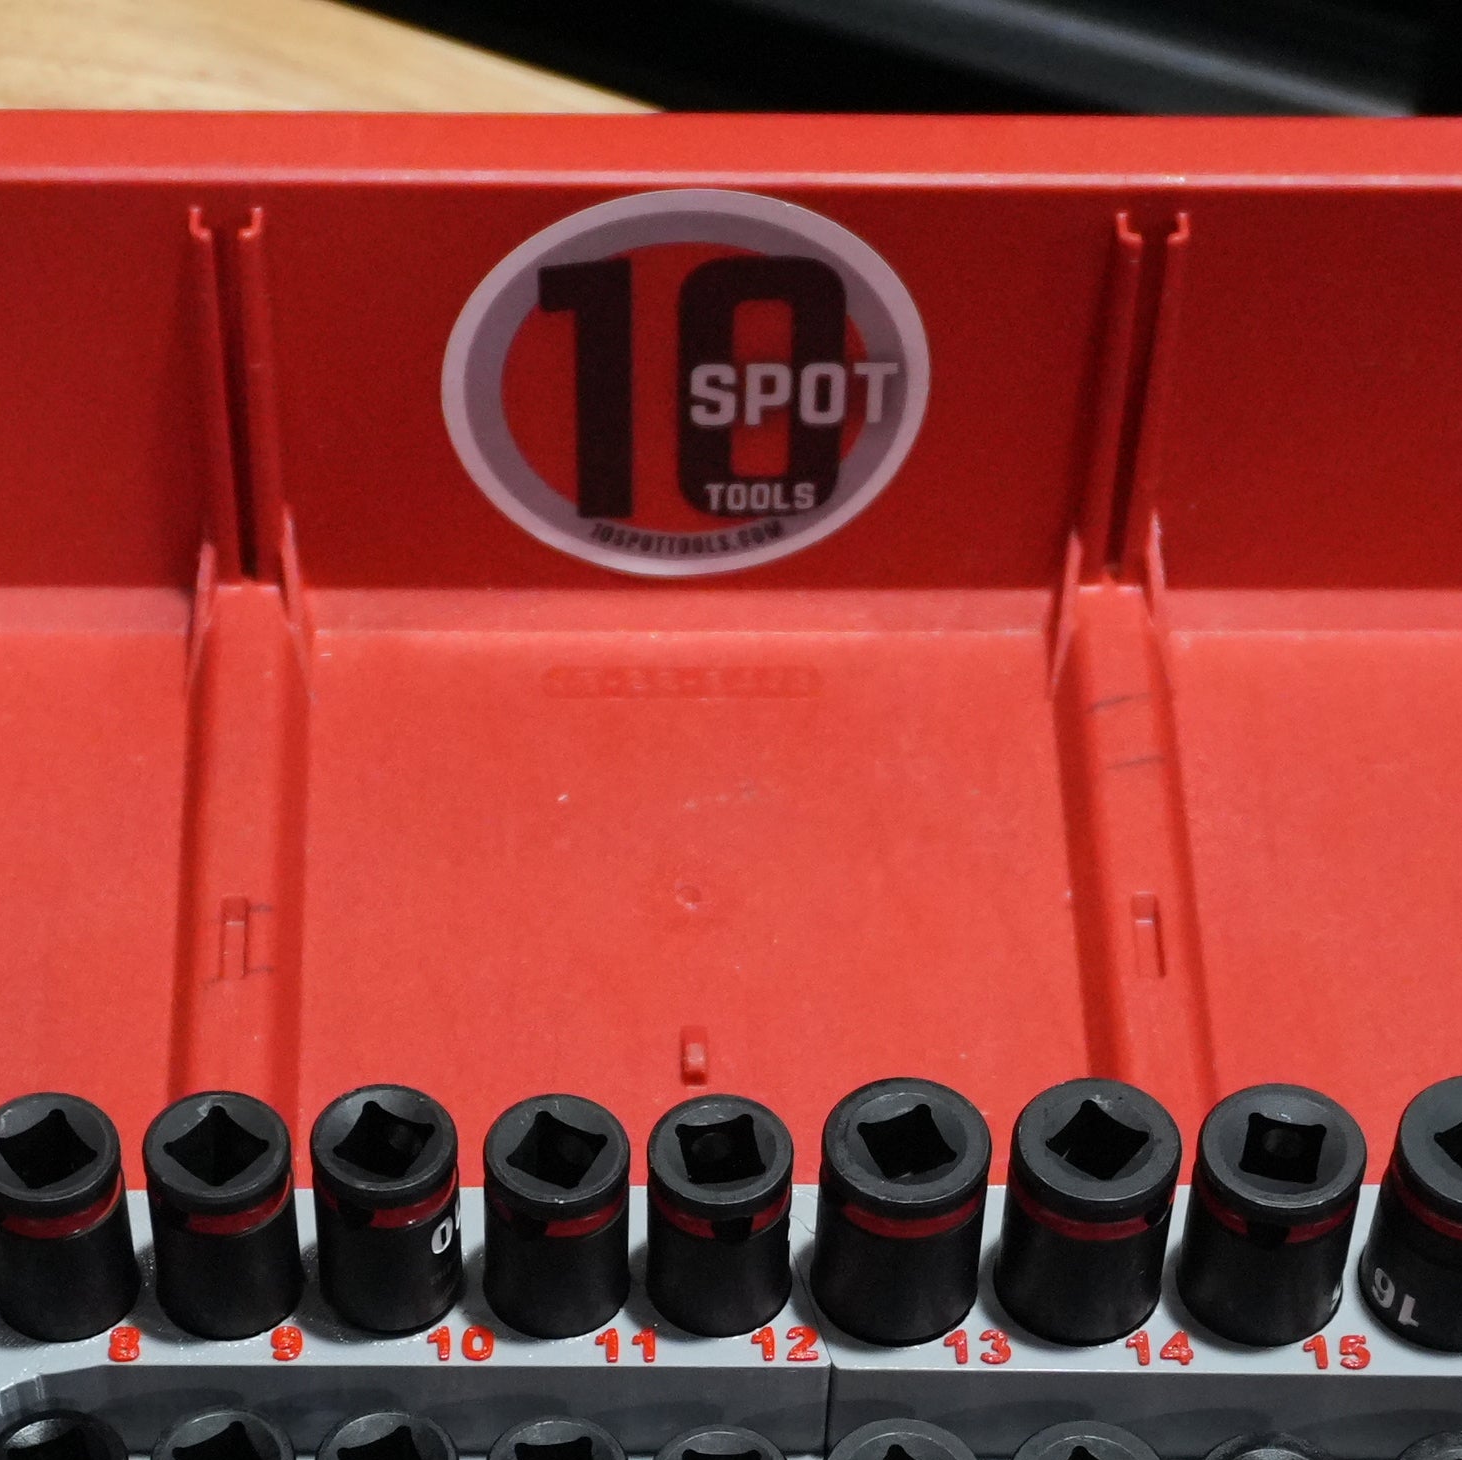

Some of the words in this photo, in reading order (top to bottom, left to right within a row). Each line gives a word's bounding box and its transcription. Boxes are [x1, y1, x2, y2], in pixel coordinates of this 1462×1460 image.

[538, 256, 846, 518] 10
[690, 362, 898, 426] SPOT
[704, 482, 816, 511] TOOLS
[109, 1327, 141, 1362] 8
[272, 1326, 303, 1361] 9
[428, 1325, 495, 1362] 10
[595, 1327, 657, 1363] 11
[751, 1325, 819, 1362] 12
[945, 1329, 1012, 1365] 13
[1127, 1331, 1197, 1365] 14
[1304, 1335, 1371, 1370] 15
